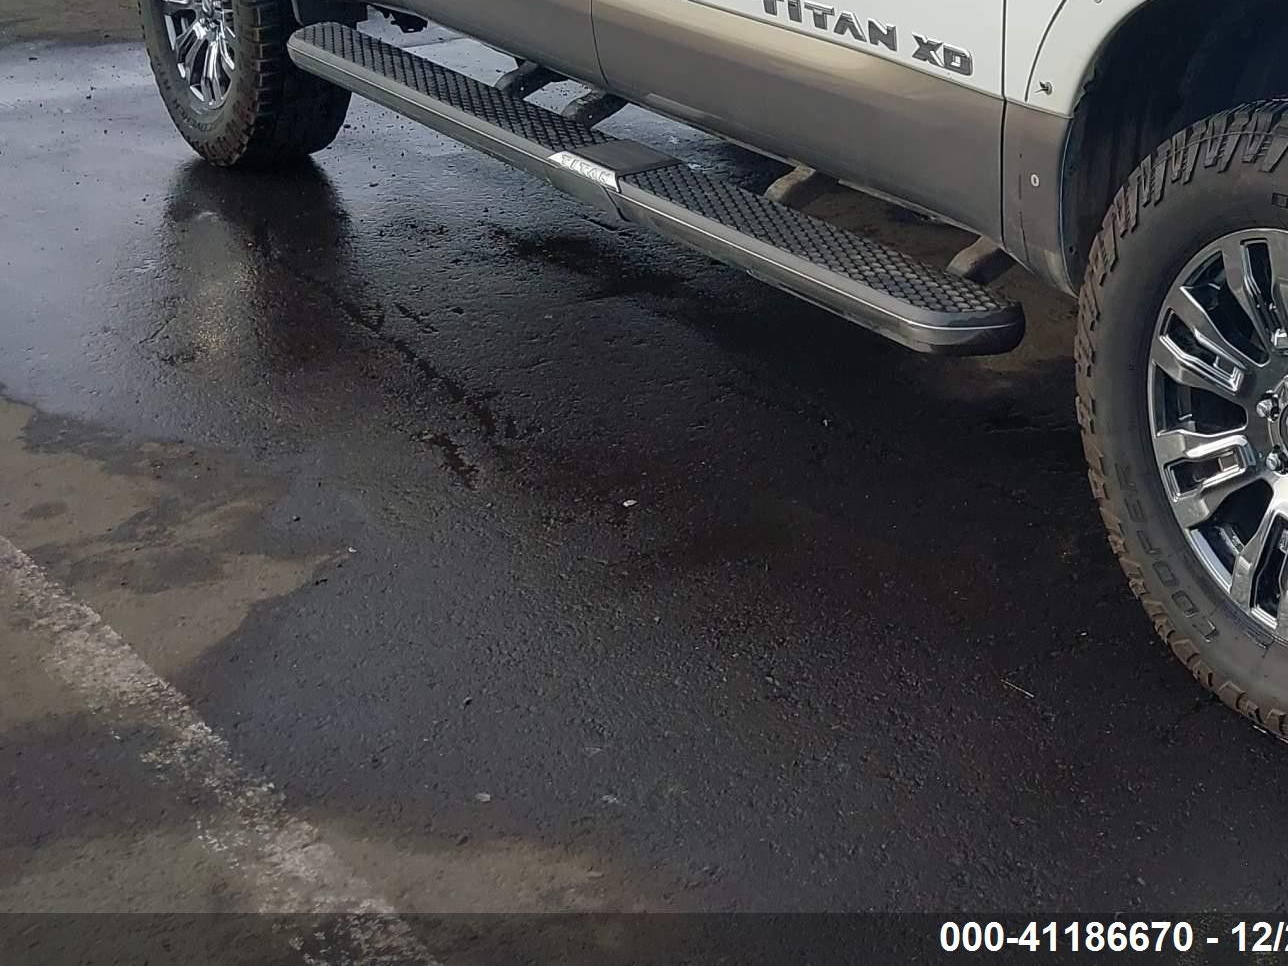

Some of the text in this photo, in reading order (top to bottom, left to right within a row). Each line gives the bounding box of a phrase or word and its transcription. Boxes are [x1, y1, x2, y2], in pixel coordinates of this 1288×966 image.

[911, 32, 975, 76] XD
[560, 153, 613, 185] TITAN
[1114, 461, 1219, 643] COOPER
